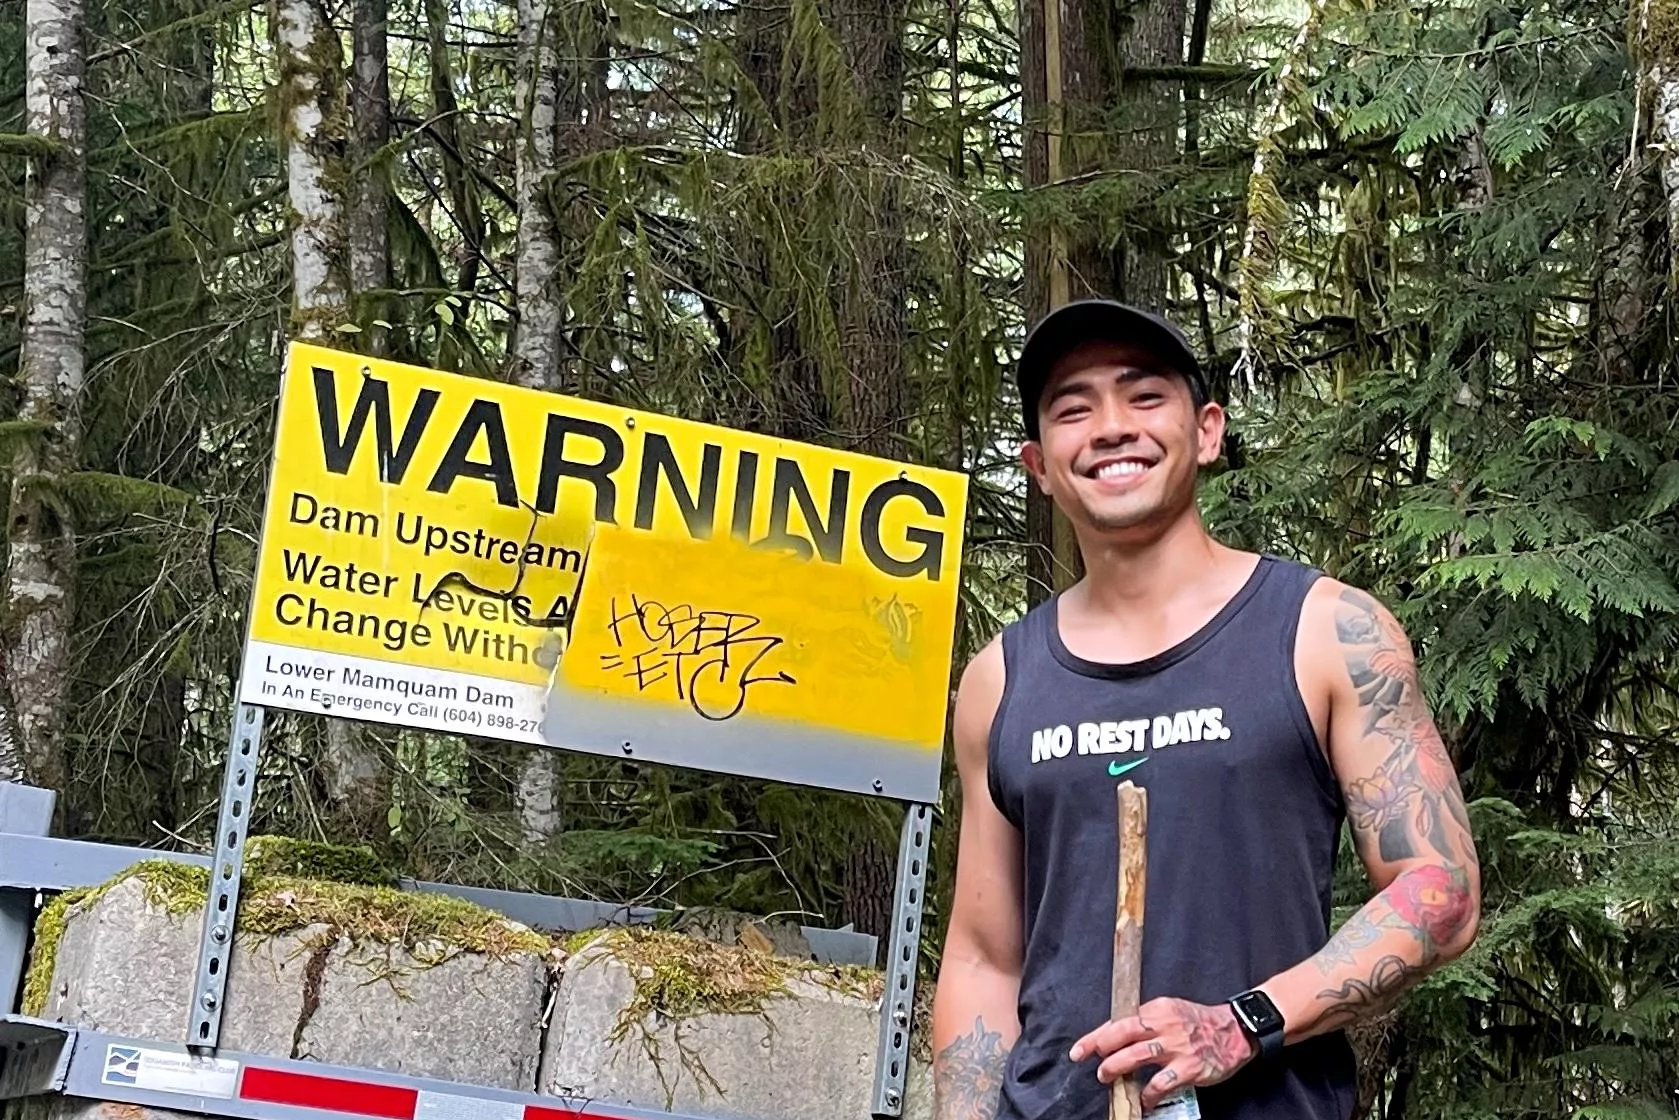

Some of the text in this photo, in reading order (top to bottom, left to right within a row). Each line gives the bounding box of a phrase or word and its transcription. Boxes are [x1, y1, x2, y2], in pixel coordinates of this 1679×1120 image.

[311, 367, 946, 581] WARNING
[289, 492, 582, 573] Dam Upstream
[283, 549, 399, 598] Water
[411, 572, 533, 627] Levels
[275, 593, 432, 651] Change
[261, 680, 277, 695] In
[282, 684, 305, 699] An
[310, 688, 402, 717] Emergency
[407, 702, 438, 718] Call
[443, 707, 482, 727] (604)
[265, 655, 514, 709] Lower Mamquam Dam
[1031, 707, 1231, 763] NO REST DAYS.
